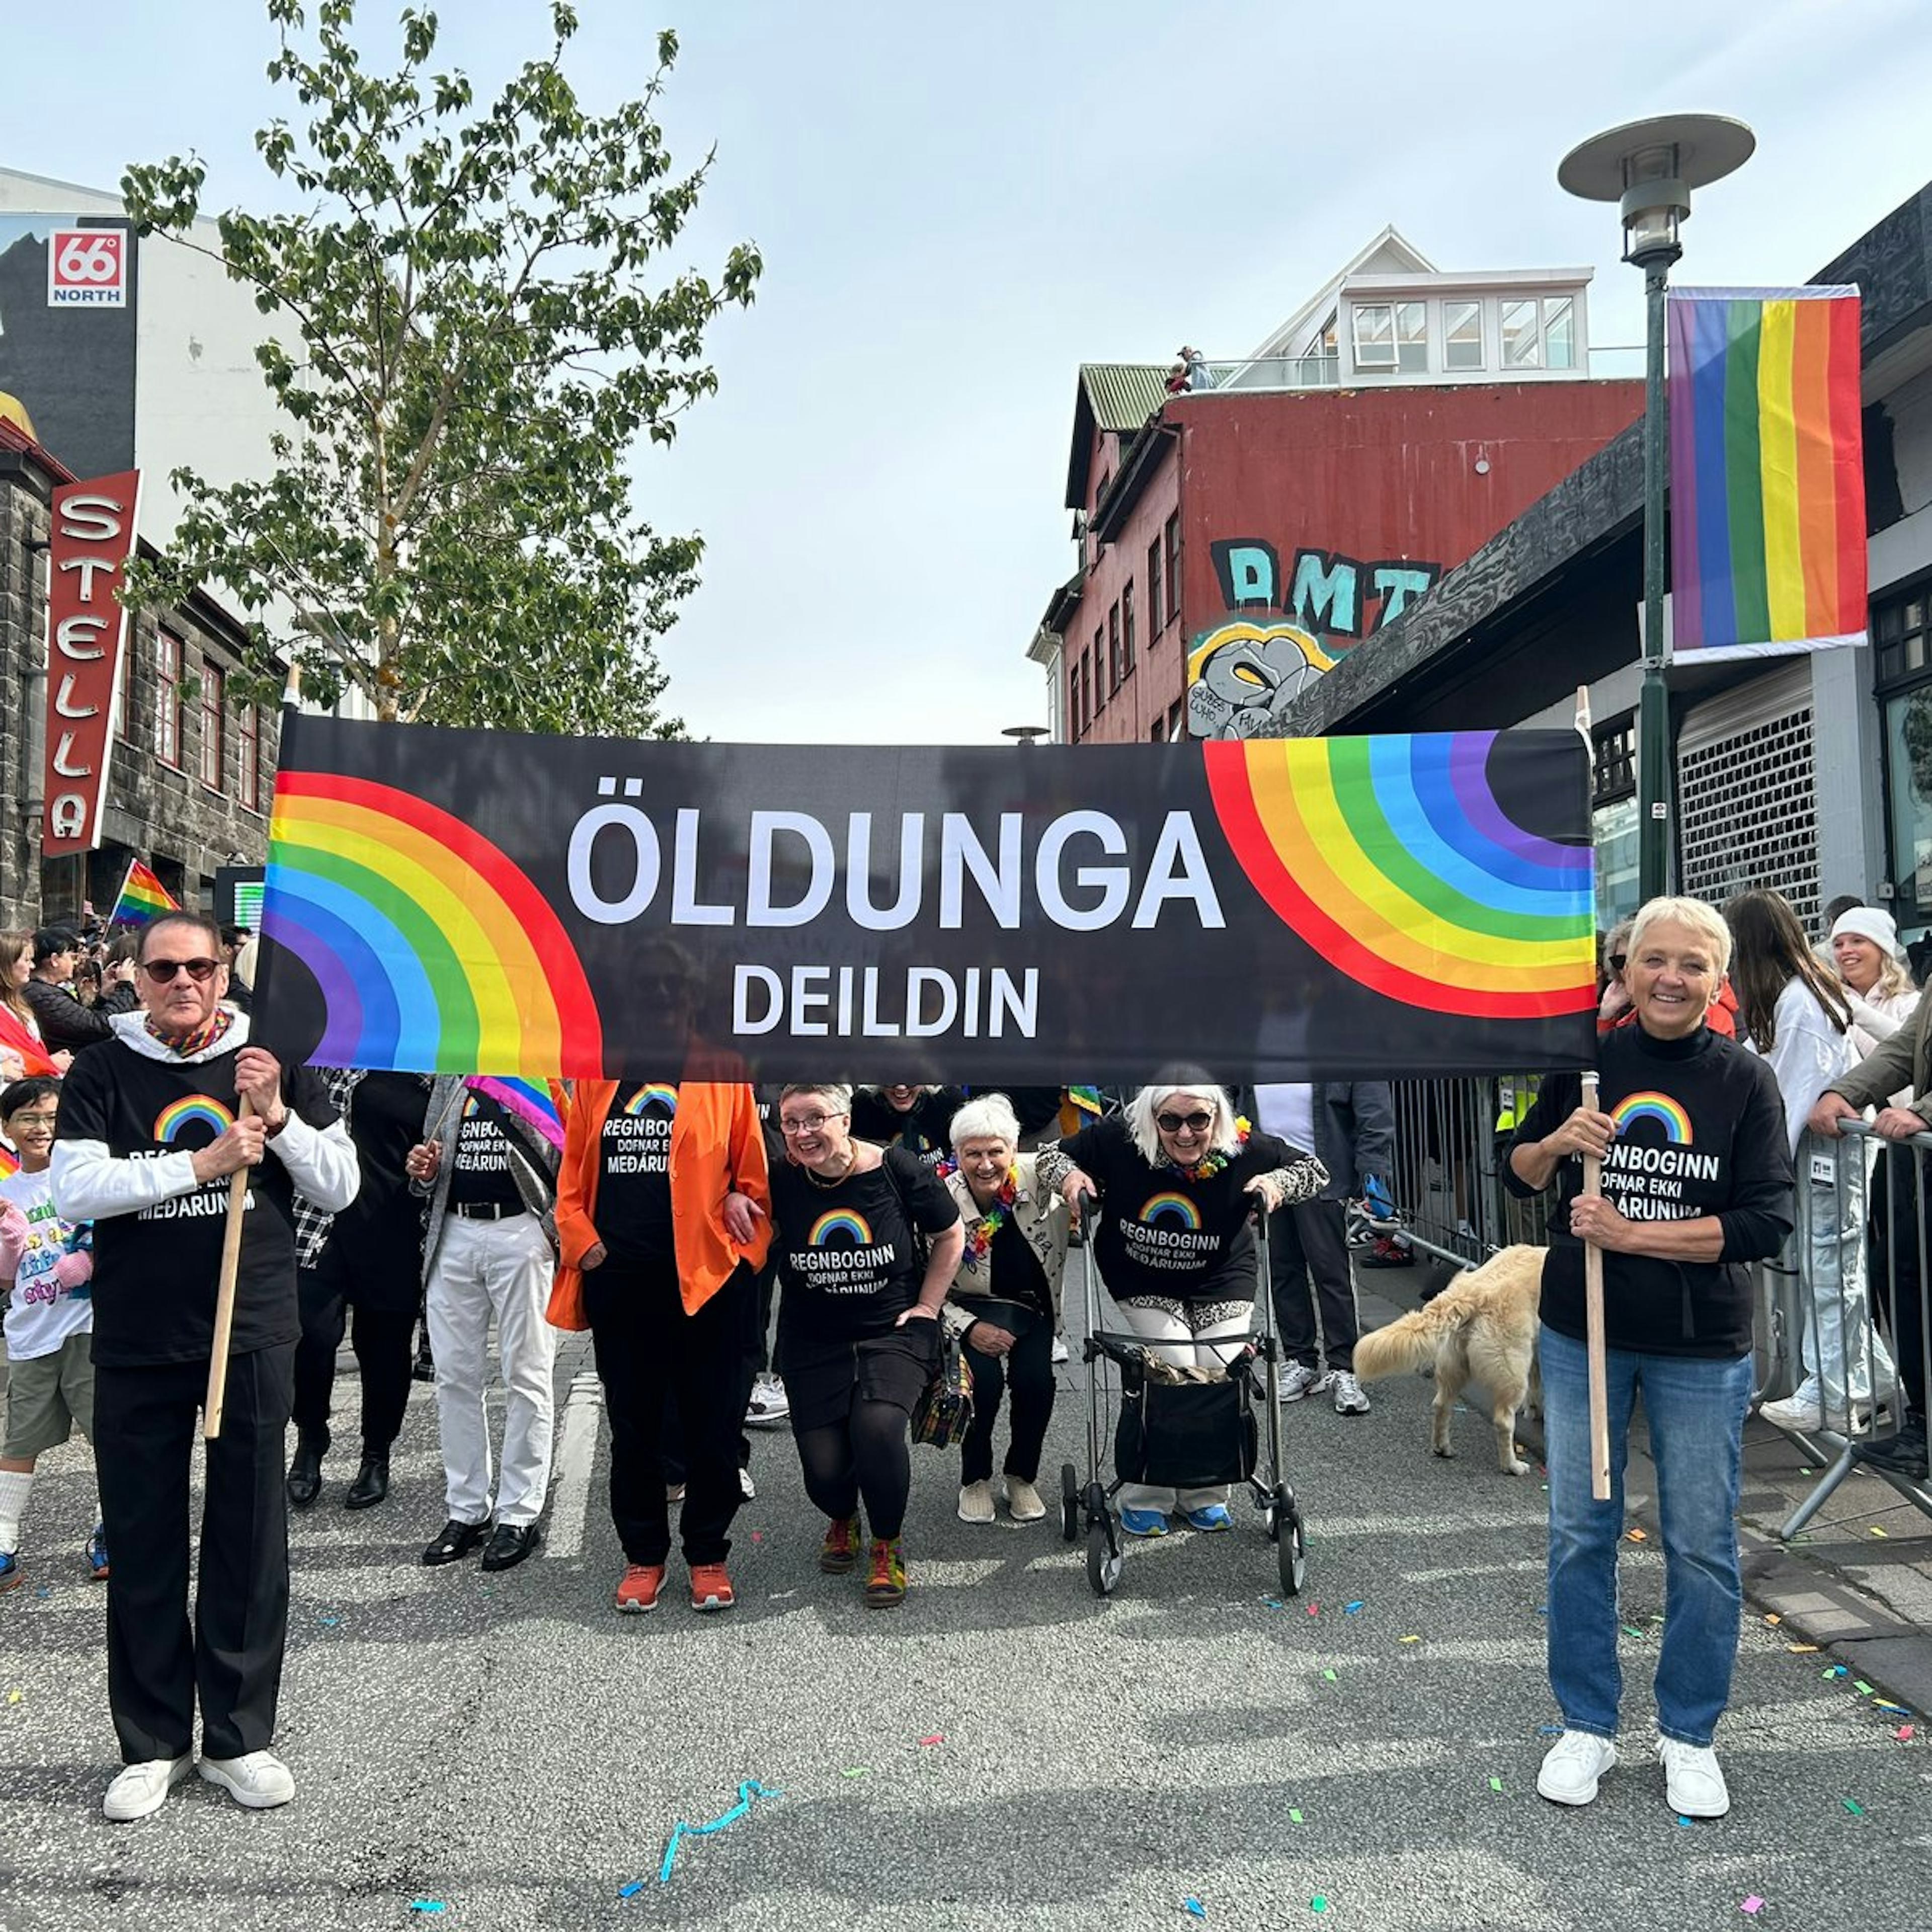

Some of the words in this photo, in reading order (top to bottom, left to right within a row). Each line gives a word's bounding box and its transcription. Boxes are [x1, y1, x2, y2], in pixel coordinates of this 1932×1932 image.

[54, 290, 120, 301] NORTH
[52, 494, 124, 839] STELLA
[567, 776, 1227, 931] ÖLDUNGA
[732, 964, 1039, 1038] DEILDIN
[617, 1139, 660, 1152] DOFNAR
[608, 1152, 670, 1173] MEÐÁRU
[1599, 1171, 1645, 1192] OFNAR
[1649, 1177, 1682, 1198] EKKI
[1119, 1218, 1220, 1251] REGNBOGINN
[789, 1243, 895, 1271] REGNBOGINN
[850, 1269, 875, 1281] EKKI
